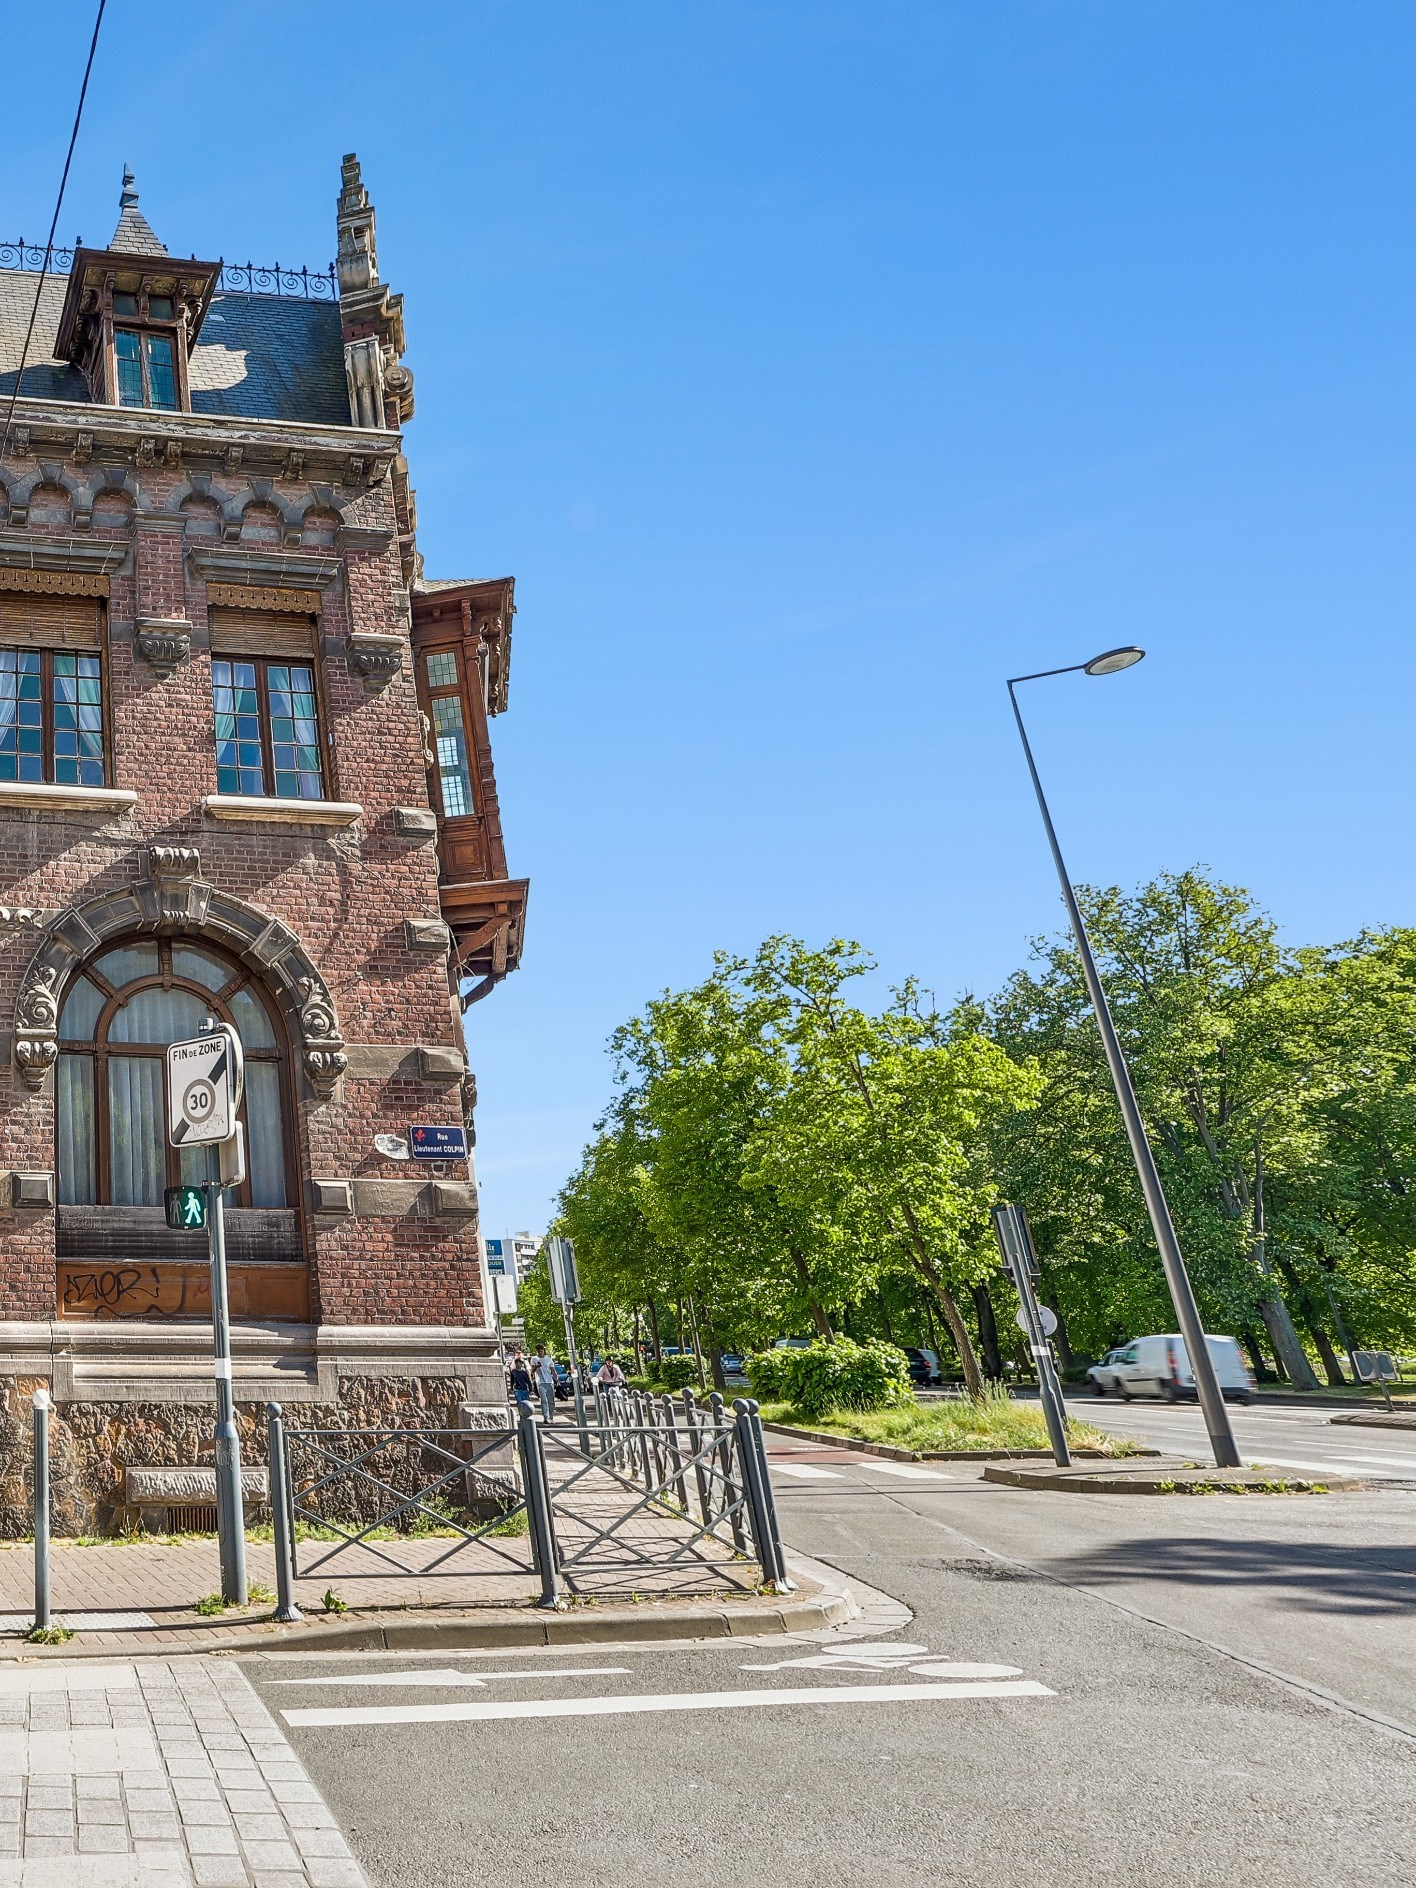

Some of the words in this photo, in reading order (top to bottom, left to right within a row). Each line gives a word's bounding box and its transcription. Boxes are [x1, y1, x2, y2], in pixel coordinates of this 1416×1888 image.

[173, 1048, 188, 1061] FIN
[189, 1049, 197, 1058] DE
[198, 1041, 222, 1056] ZONE
[190, 1092, 208, 1110] 30
[414, 1145, 443, 1153] Lieutenant
[443, 1145, 464, 1153] COLPIN
